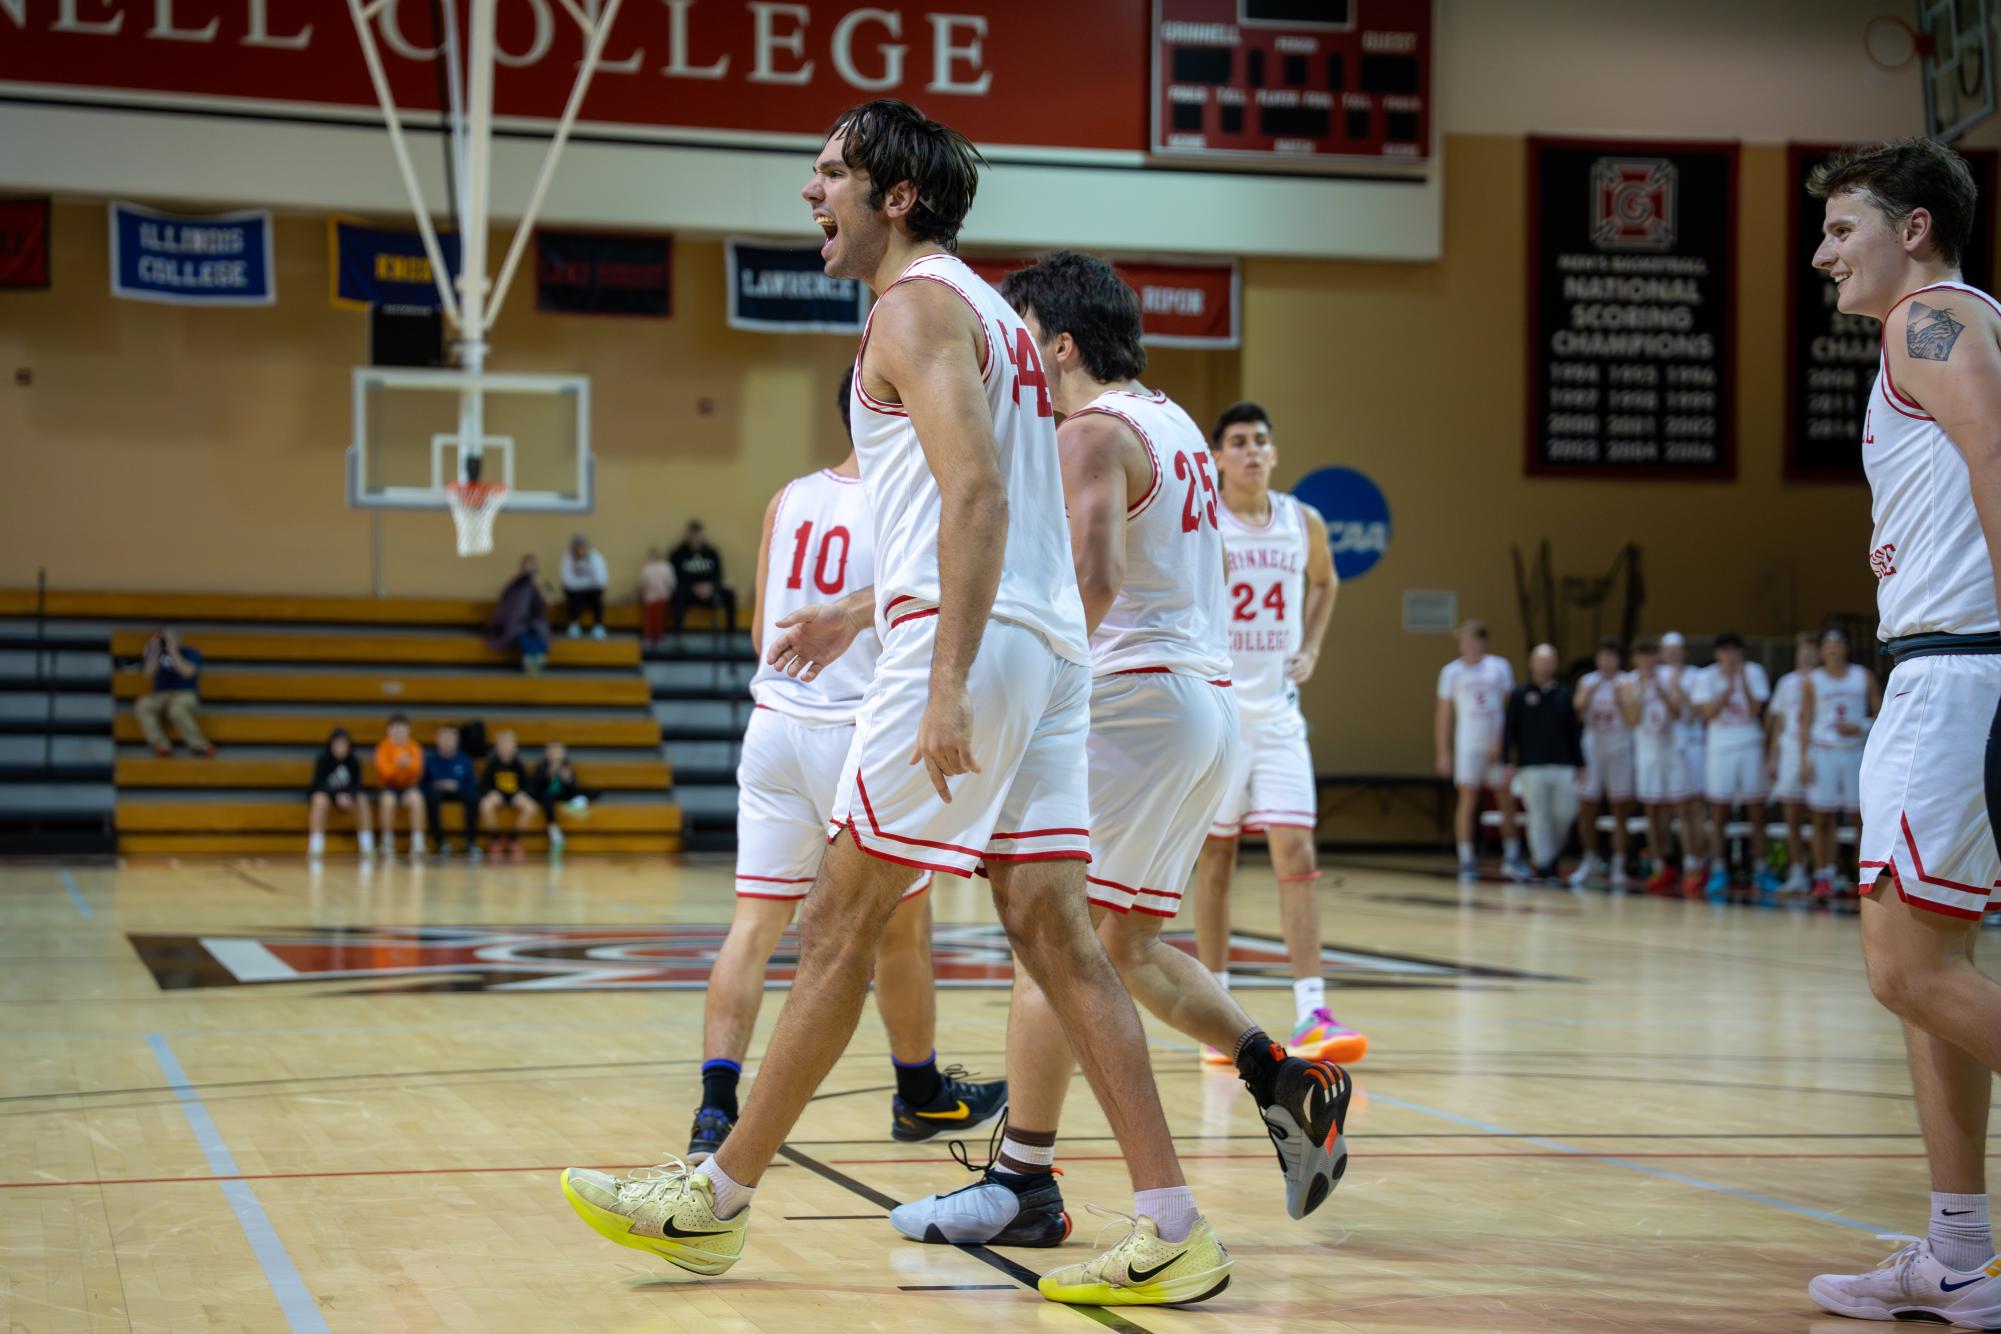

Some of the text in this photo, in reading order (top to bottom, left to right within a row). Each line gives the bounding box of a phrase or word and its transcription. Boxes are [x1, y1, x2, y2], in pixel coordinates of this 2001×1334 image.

[372, 0, 993, 95] COLLEGE
[139, 222, 244, 255] ILLINOIS
[138, 256, 248, 288] COLLEGE
[741, 268, 855, 301] LAWRENCE
[1143, 285, 1206, 316] RIPON
[1564, 275, 1702, 303] NATIONAL
[1571, 304, 1694, 331] SCORING
[1552, 330, 1714, 359] CHAMPIONS
[1174, 450, 1218, 533] 25
[1328, 521, 1386, 553] CAA
[786, 520, 850, 595] 10
[1228, 549, 1296, 573] RINNELL
[1231, 582, 1285, 621] 24
[1229, 630, 1289, 651] OLLEG
